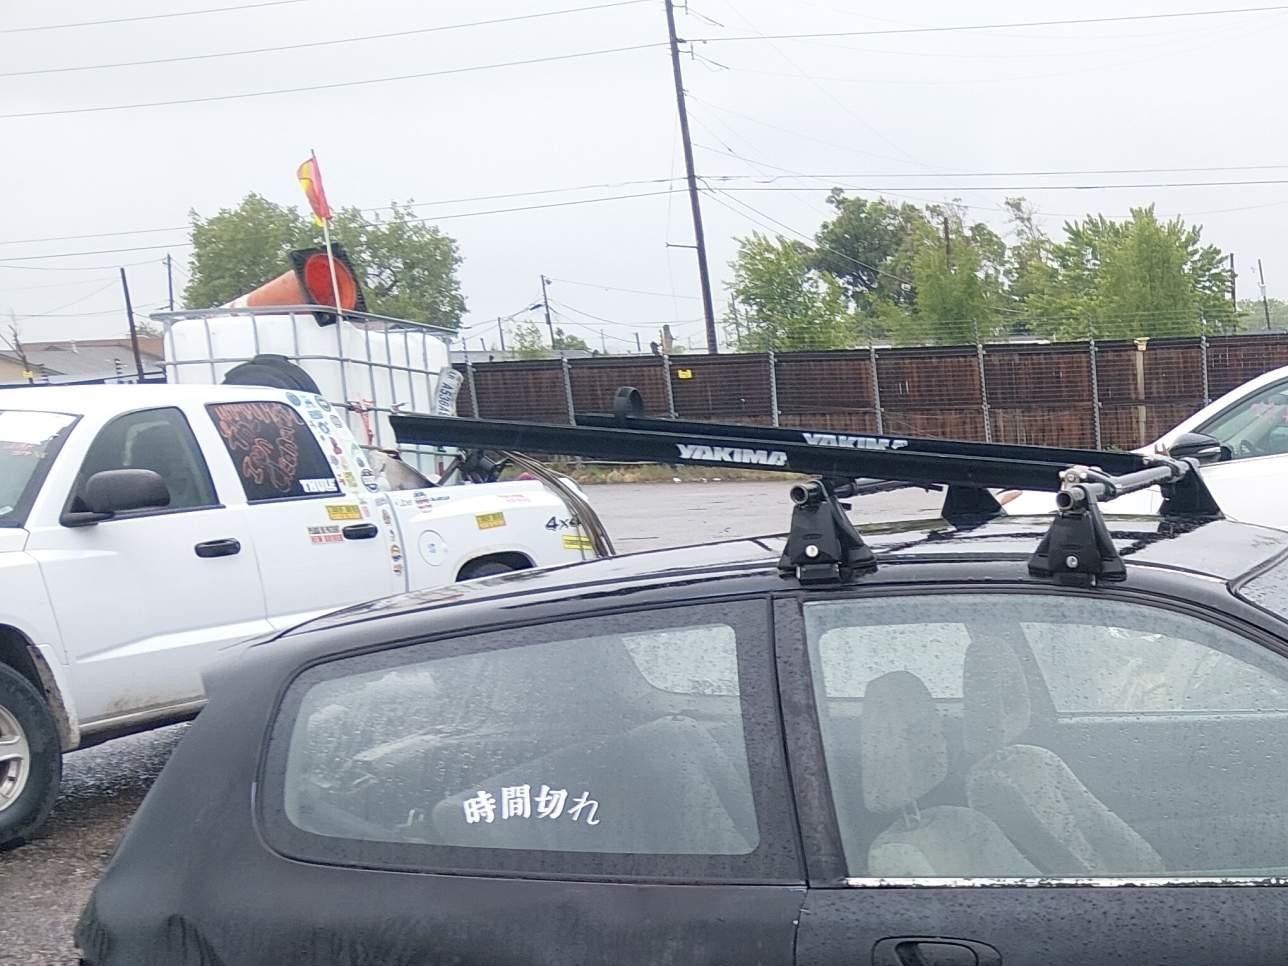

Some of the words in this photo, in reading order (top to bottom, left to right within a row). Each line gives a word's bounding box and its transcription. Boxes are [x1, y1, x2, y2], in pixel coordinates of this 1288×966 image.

[677, 443, 788, 467] YAKIMA
[463, 784, 601, 825] 時間切れ
